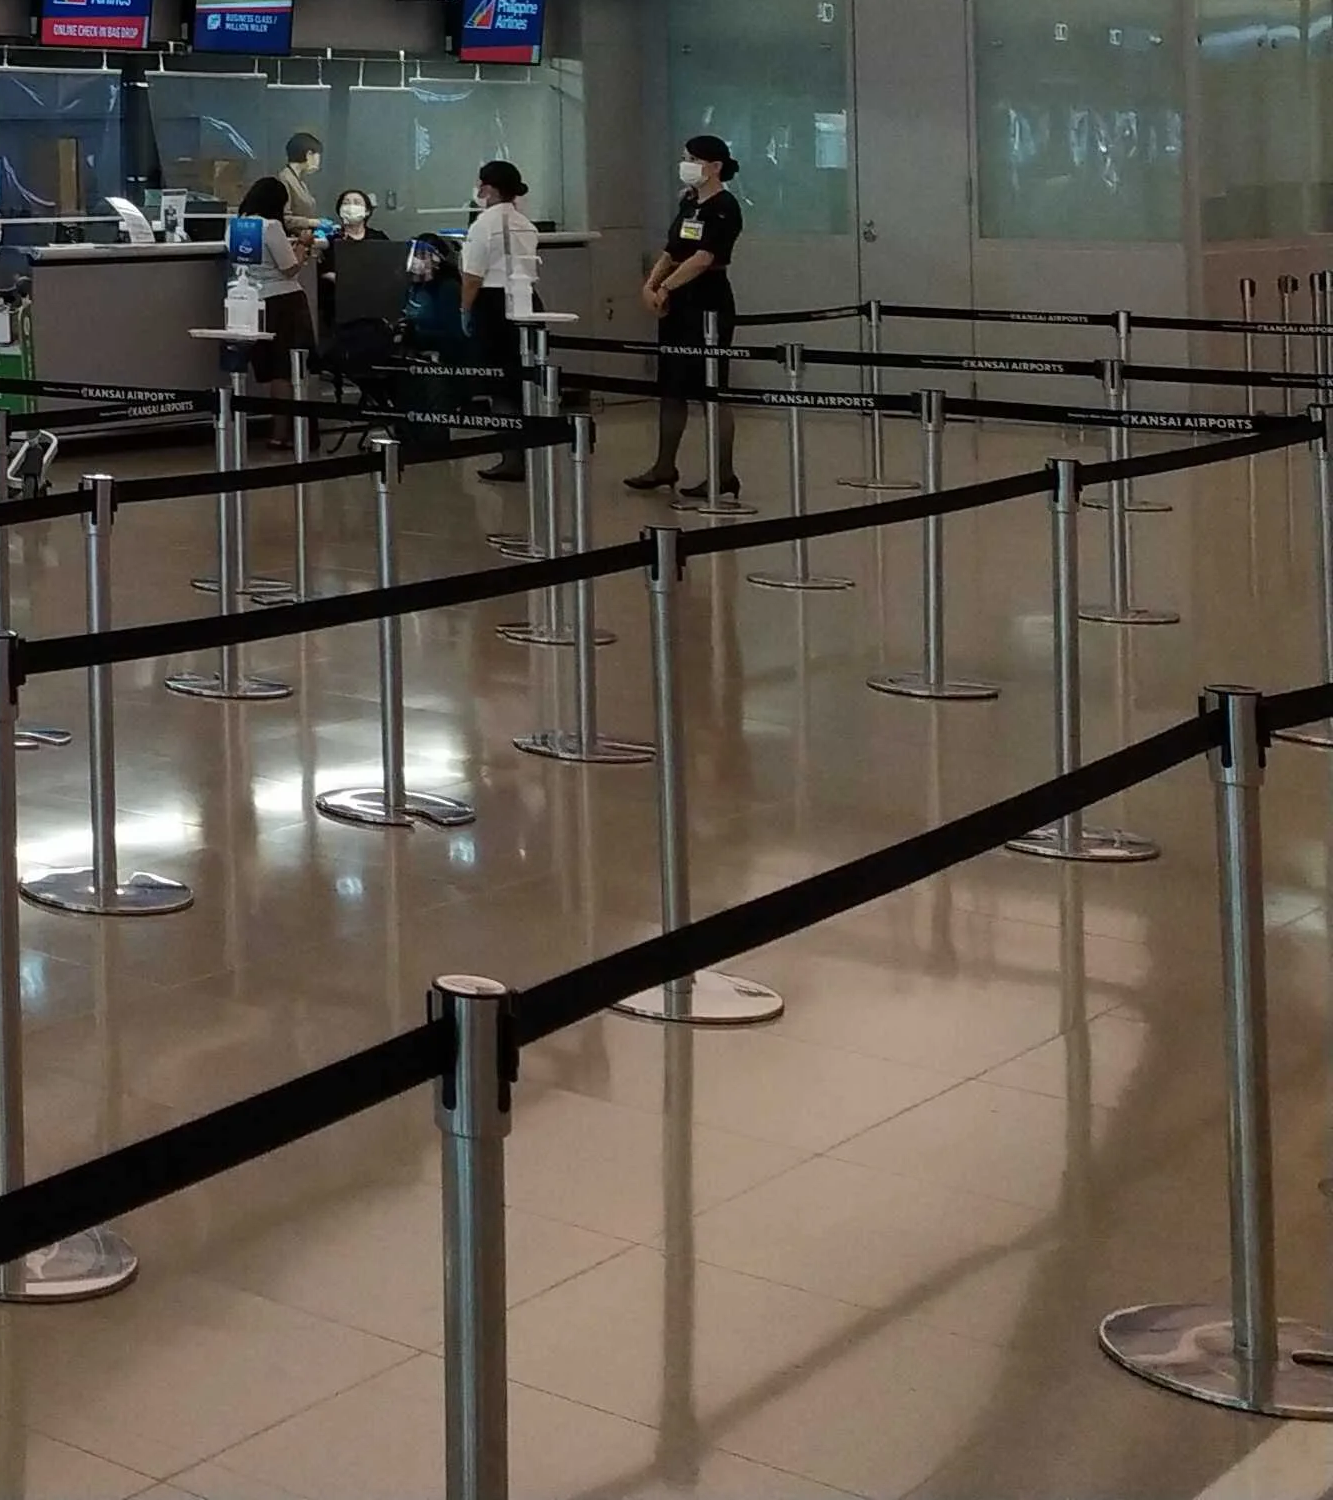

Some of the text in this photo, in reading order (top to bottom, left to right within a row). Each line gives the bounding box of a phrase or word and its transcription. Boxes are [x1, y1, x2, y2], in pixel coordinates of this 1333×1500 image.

[494, 14, 529, 30] Airlines
[53, 23, 77, 37] ONLINE
[415, 366, 505, 377] KANSAI AIRPORTS
[968, 360, 1064, 372] KANSAI AIRPORTS
[88, 388, 125, 400] KANSAI
[771, 394, 875, 408] KANSAI AIRPORTS
[415, 412, 523, 429] KANSAI AIRPORTS
[1131, 414, 1253, 430] KANSAI AIRPORTS
